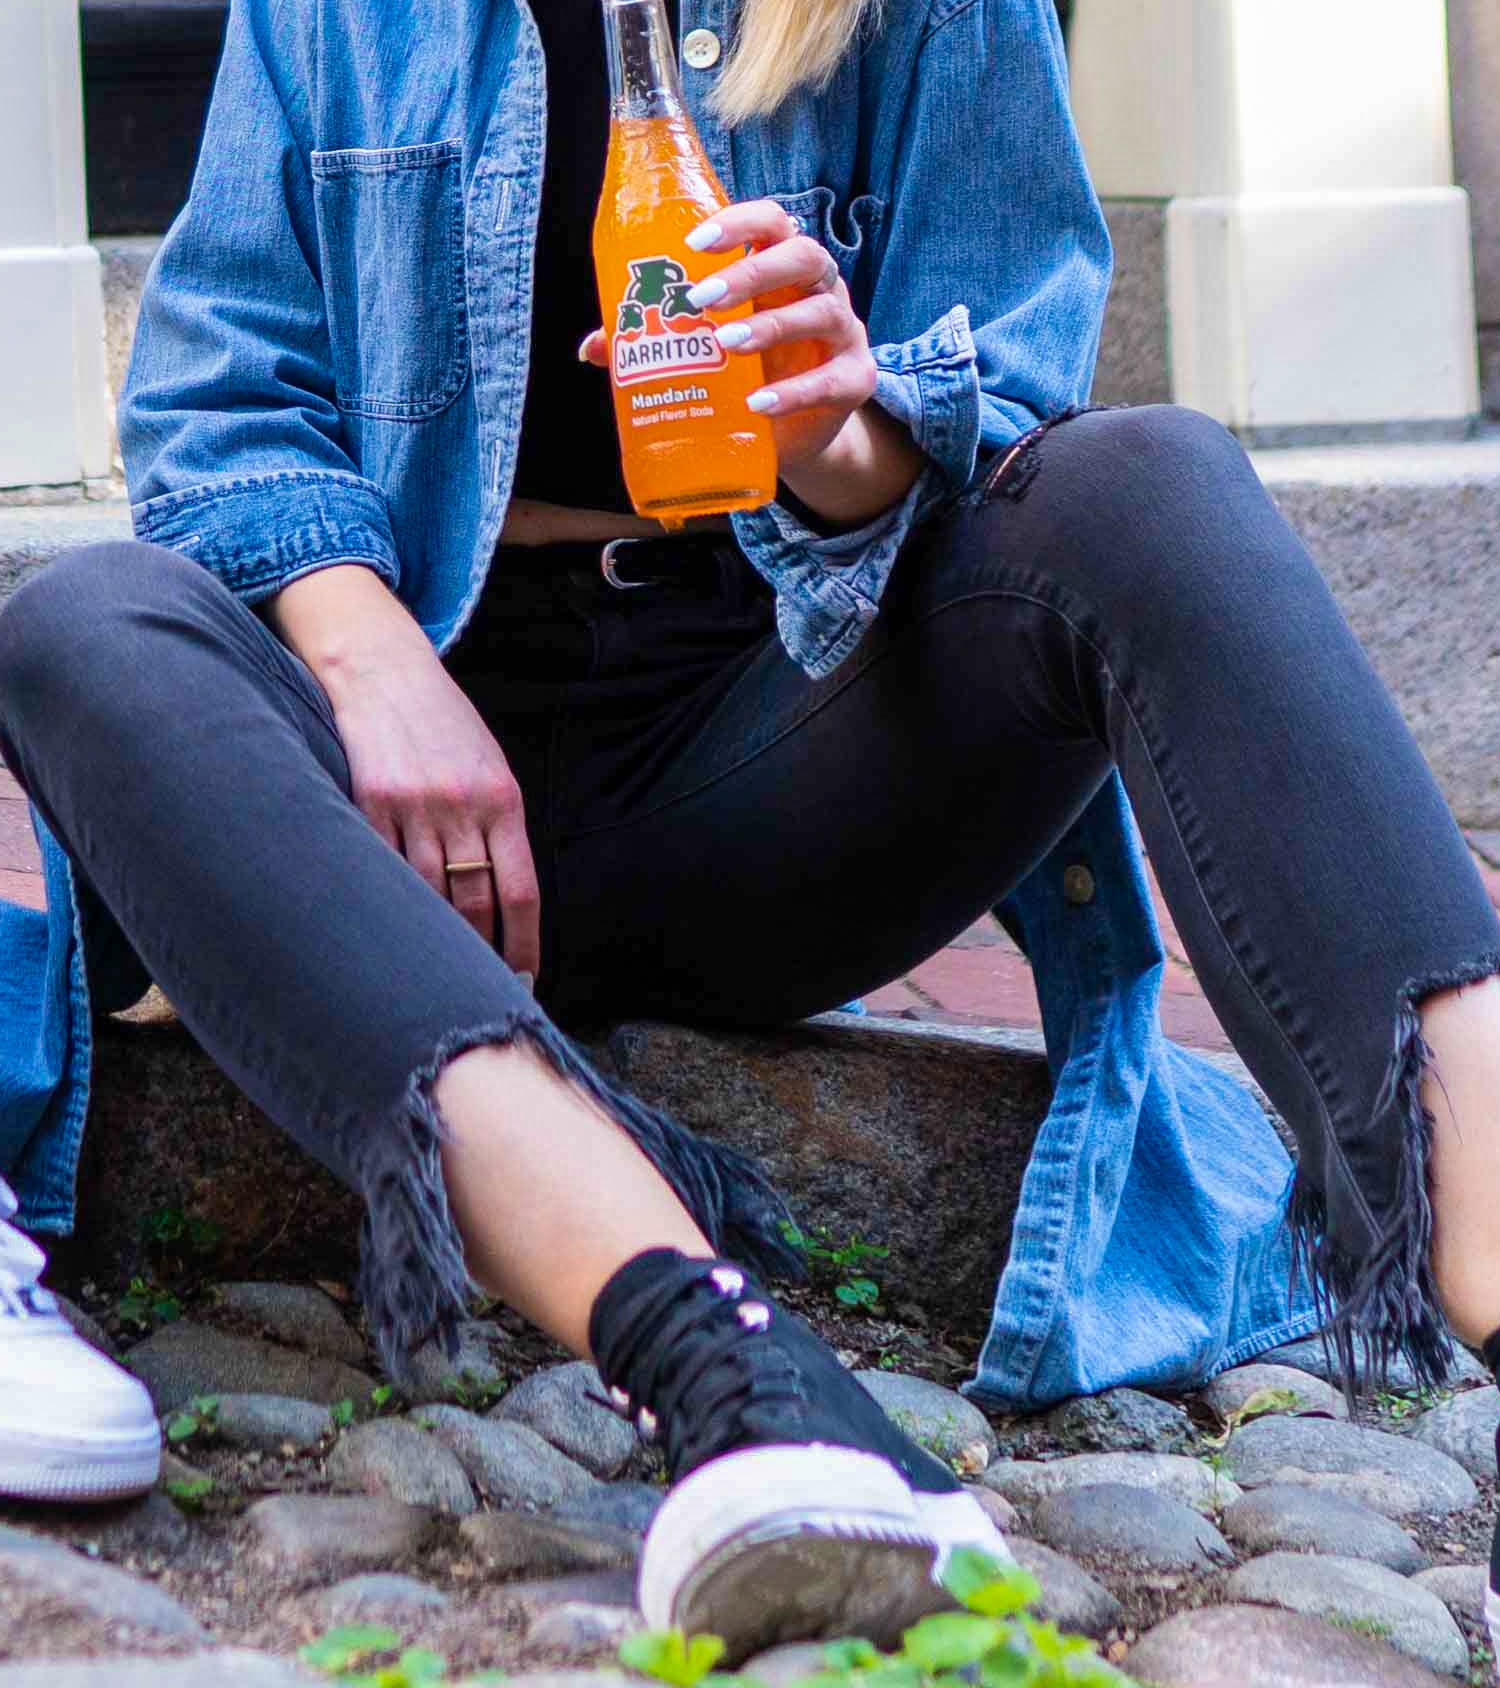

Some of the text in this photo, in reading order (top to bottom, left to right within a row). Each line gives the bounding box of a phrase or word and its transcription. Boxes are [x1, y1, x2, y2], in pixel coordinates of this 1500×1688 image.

[619, 336, 713, 369] JARRITOS
[631, 385, 708, 410] Mandarin
[660, 409, 687, 421] Flavor
